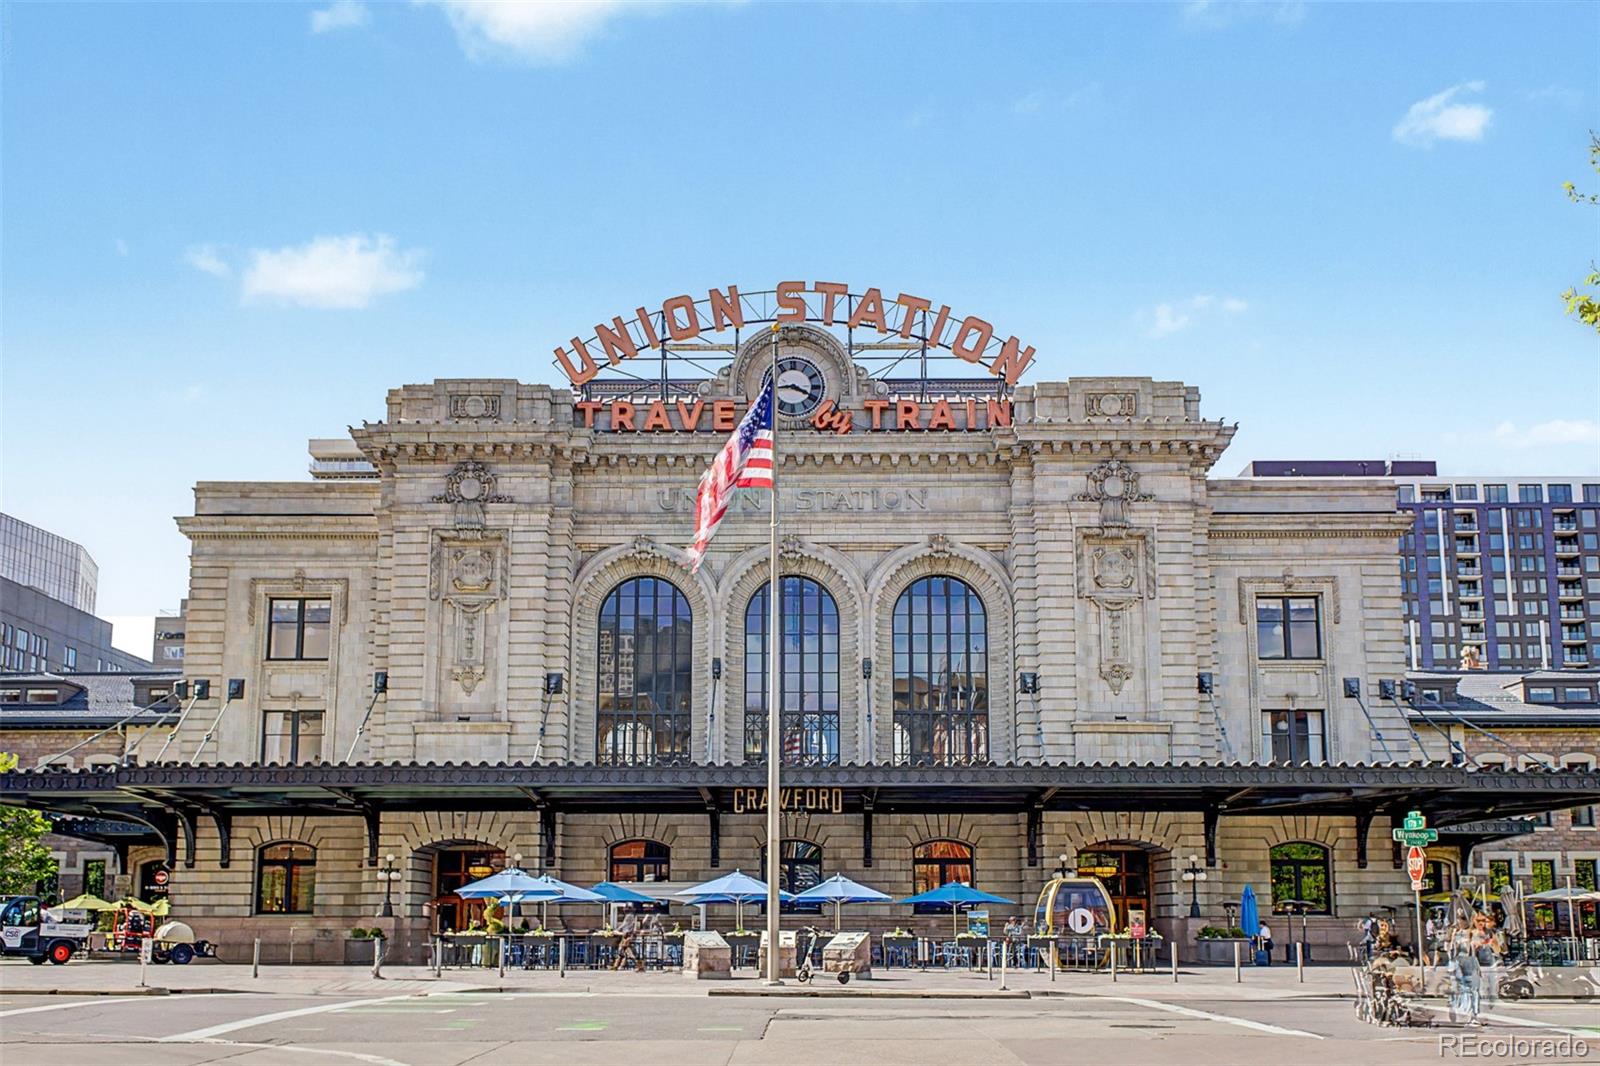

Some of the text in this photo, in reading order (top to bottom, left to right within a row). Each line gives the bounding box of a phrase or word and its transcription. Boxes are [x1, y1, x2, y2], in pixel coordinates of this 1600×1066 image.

[553, 280, 1036, 386] UNION STATION
[577, 399, 1011, 434] TRAVE by TRAIN
[796, 488, 927, 510] STATION
[1396, 829, 1429, 840] Wynkoop
